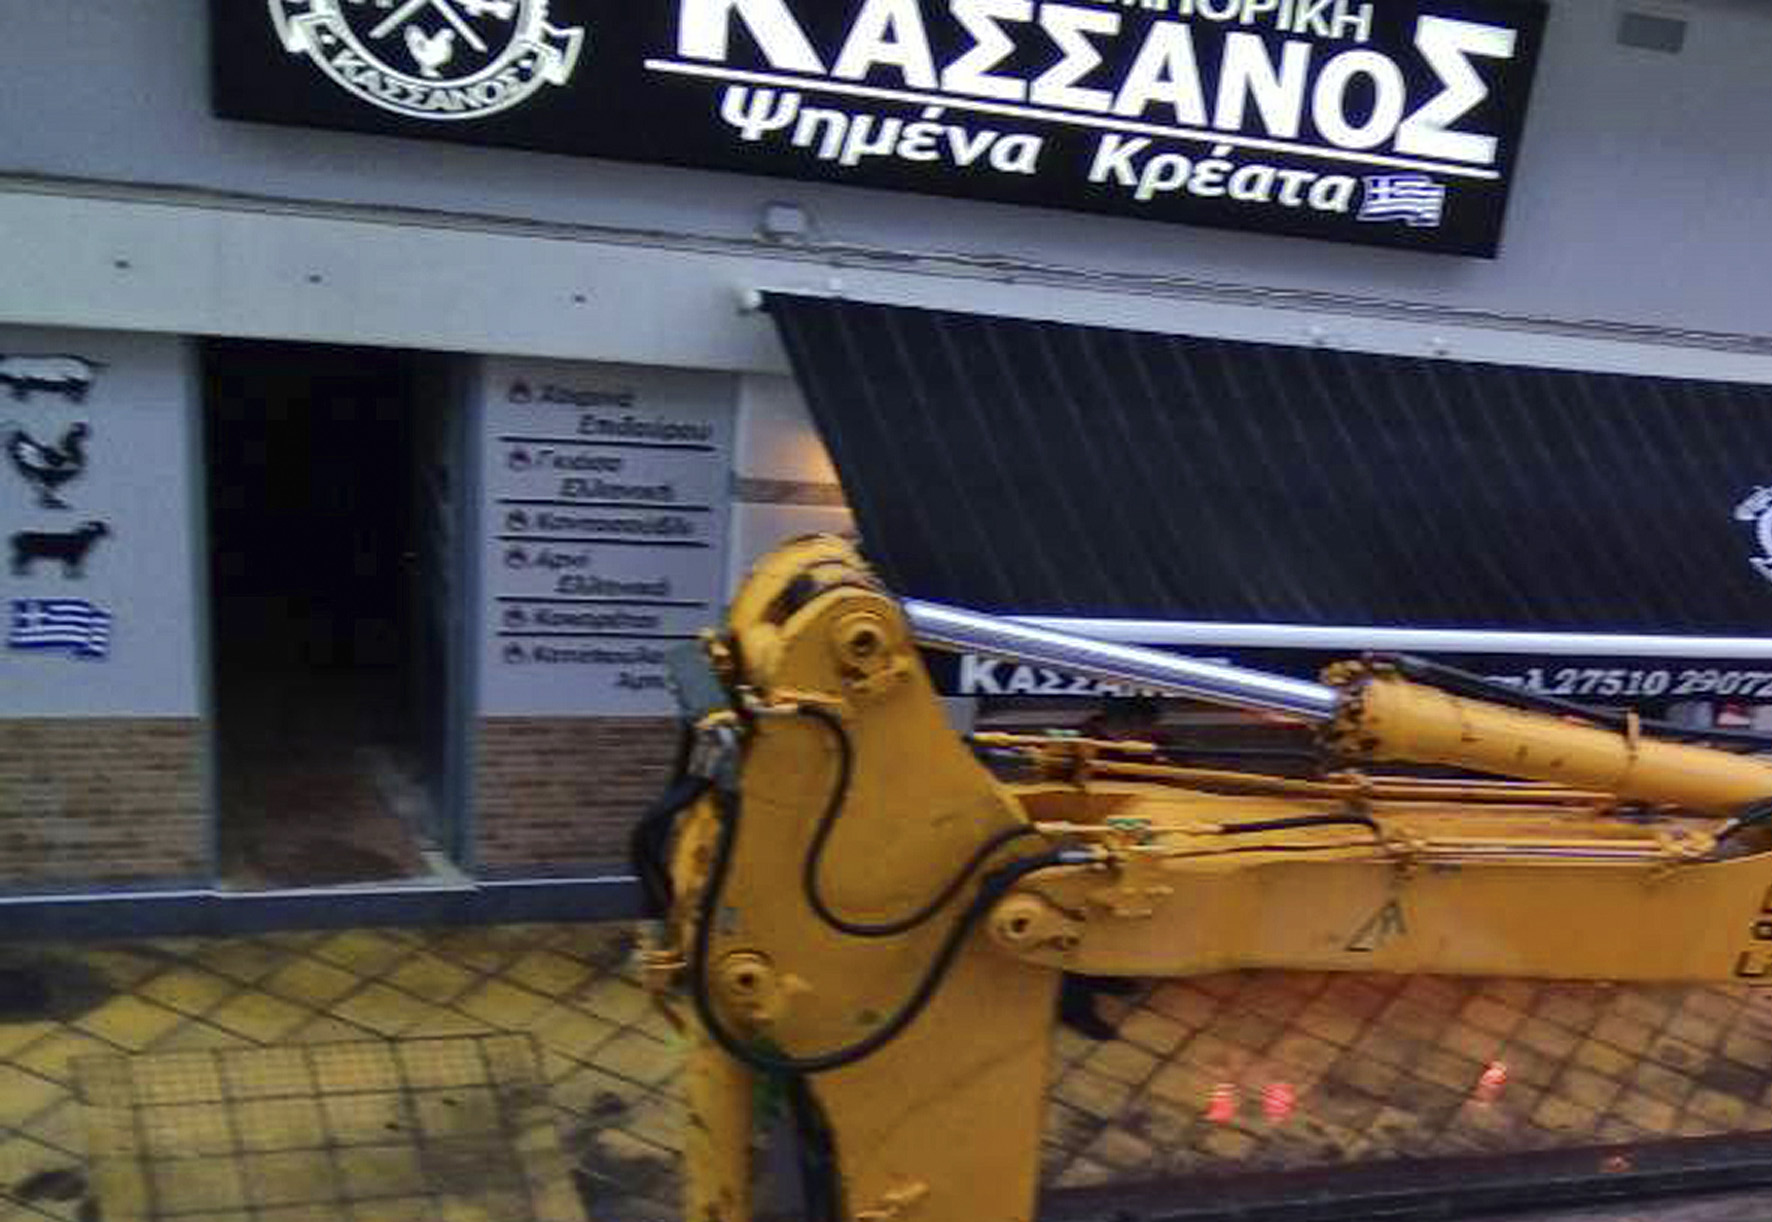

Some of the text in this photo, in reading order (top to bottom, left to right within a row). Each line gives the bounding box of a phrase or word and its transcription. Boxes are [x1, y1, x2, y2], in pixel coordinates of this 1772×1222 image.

[1100, 0, 1373, 42] ΟΡΙΚΗ
[330, 48, 522, 113] ΚΑΣΣΑΝΟΣ
[719, 85, 1356, 213] Ψημένα Κρέατα
[1554, 668, 1669, 697] 27510
